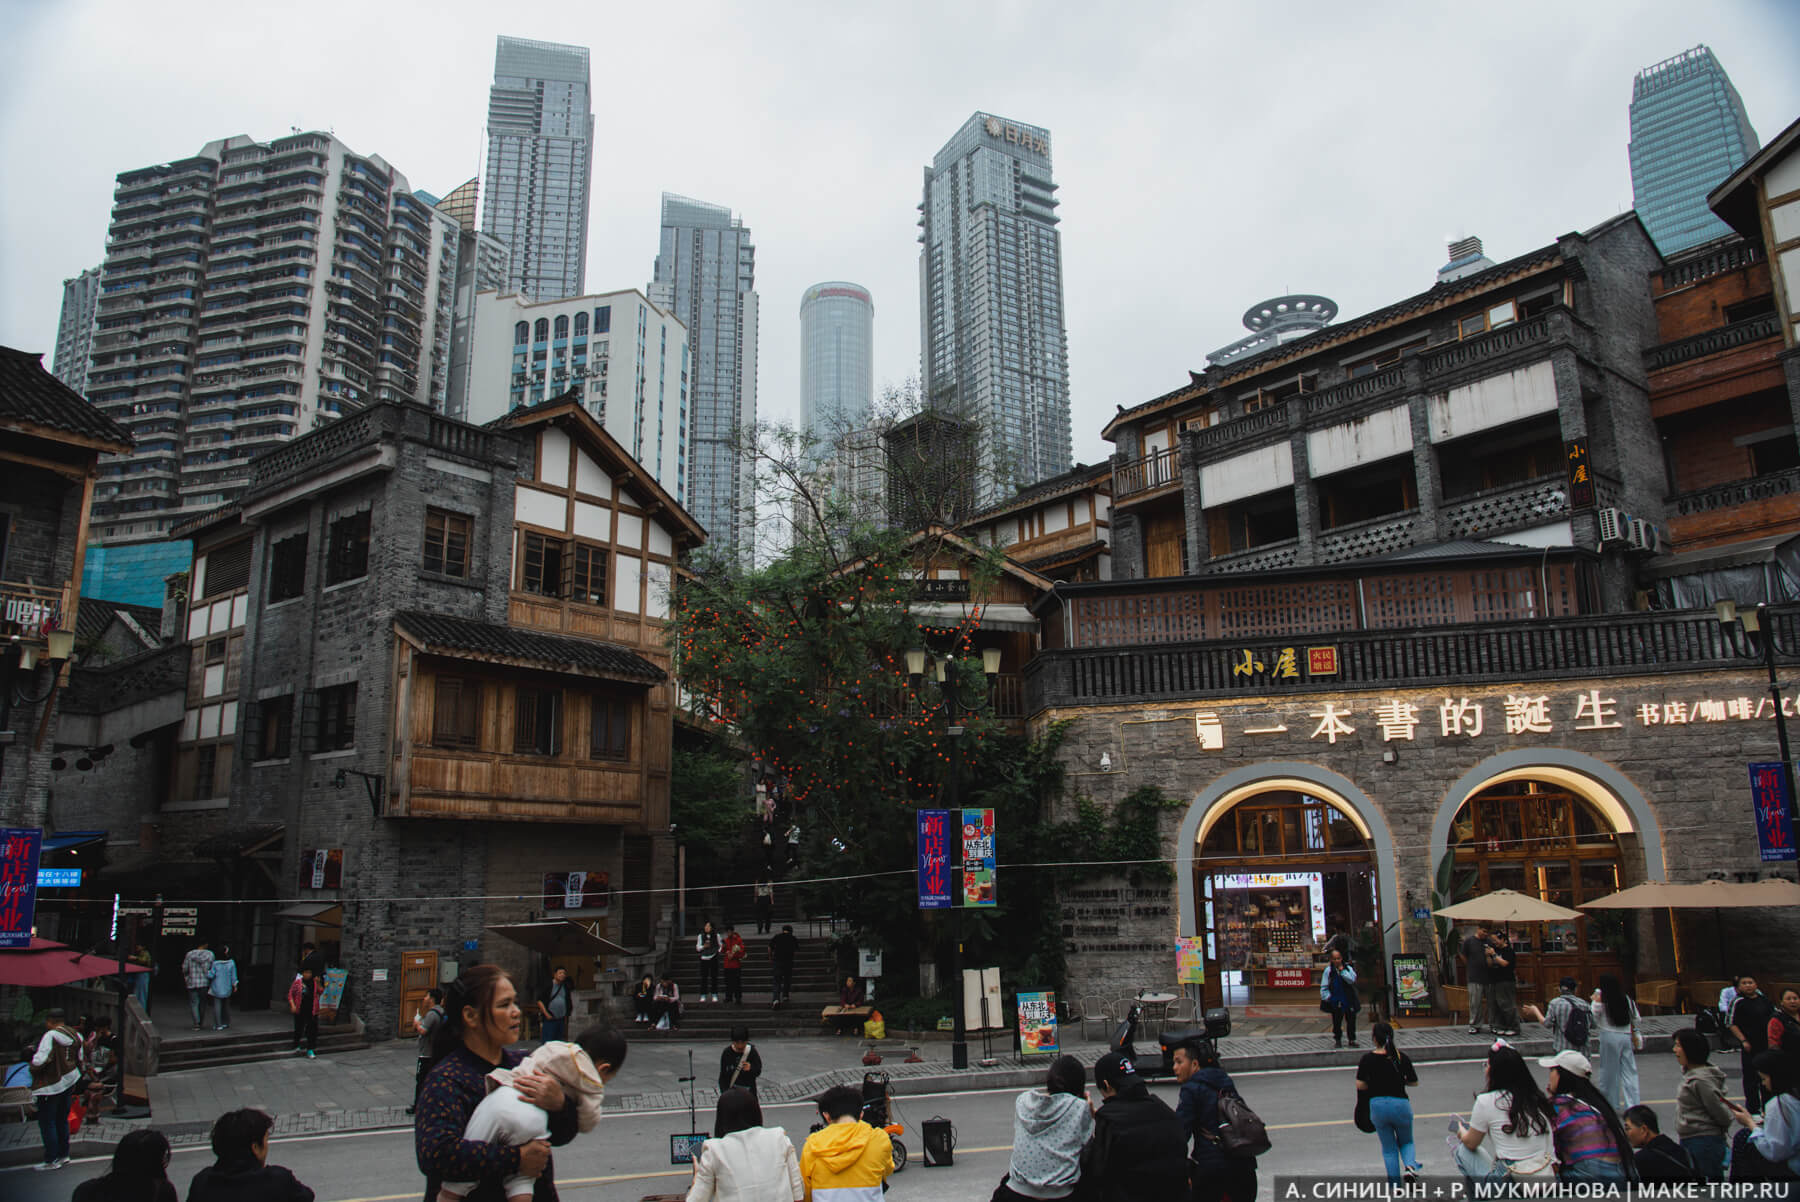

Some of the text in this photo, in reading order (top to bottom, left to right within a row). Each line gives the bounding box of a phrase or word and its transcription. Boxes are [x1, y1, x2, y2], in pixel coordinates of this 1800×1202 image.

[1233, 647, 1299, 678] 小屋
[1243, 690, 1623, 744] 一本書的誕生
[1636, 696, 1800, 726] 书店/咖啡/文
